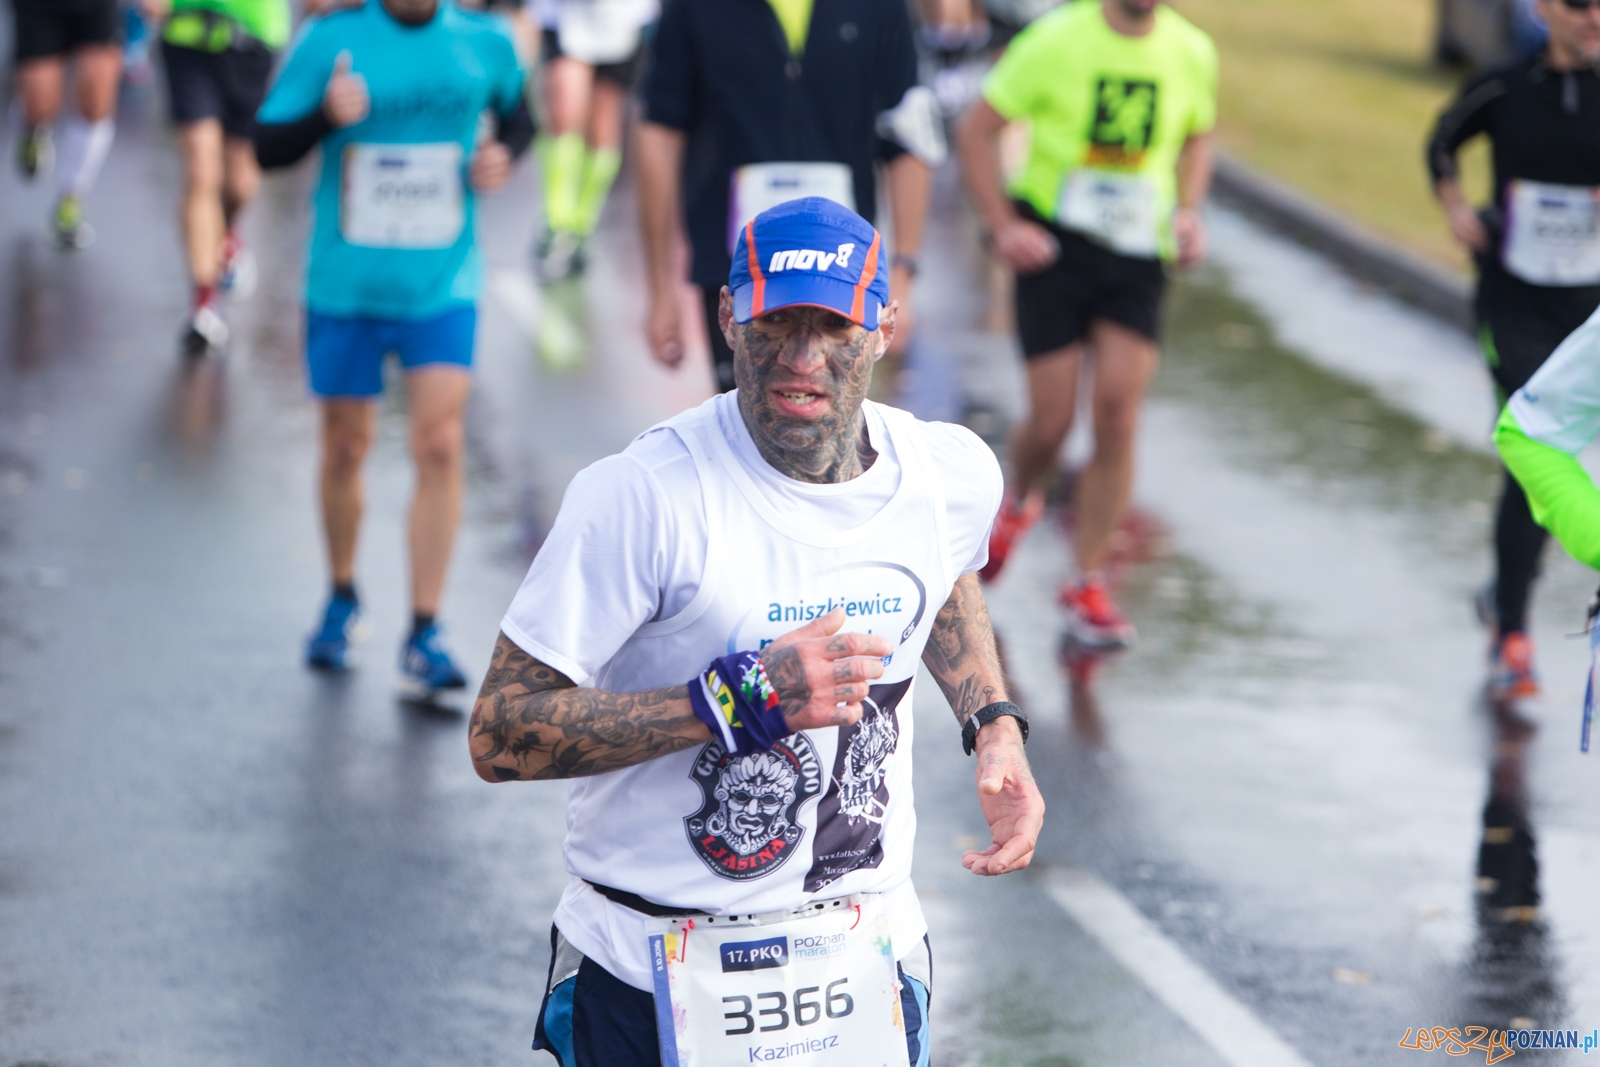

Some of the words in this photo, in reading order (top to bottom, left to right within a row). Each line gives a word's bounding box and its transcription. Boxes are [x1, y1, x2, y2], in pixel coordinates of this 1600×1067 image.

[767, 592, 903, 622] aniszkiewicz
[795, 943, 847, 959] maraton
[722, 977, 855, 1036] 3366
[748, 1034, 840, 1063] Kazimierz
